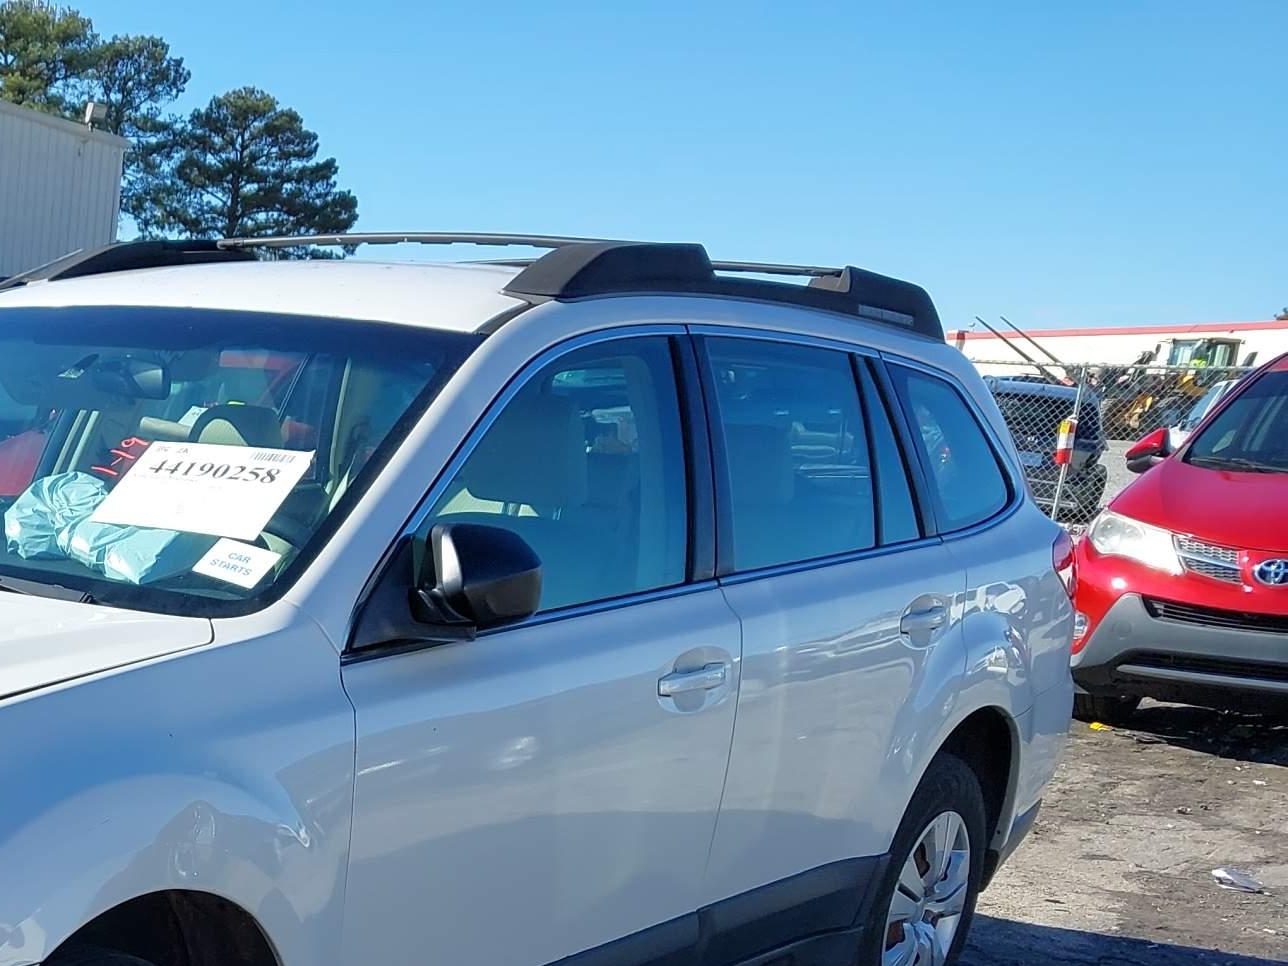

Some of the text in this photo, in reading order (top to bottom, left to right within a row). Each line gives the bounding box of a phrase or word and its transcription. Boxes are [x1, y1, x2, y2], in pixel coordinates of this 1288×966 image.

[148, 459, 282, 484] 44190258
[209, 558, 253, 577] STARTS
[227, 552, 252, 564] CAR
